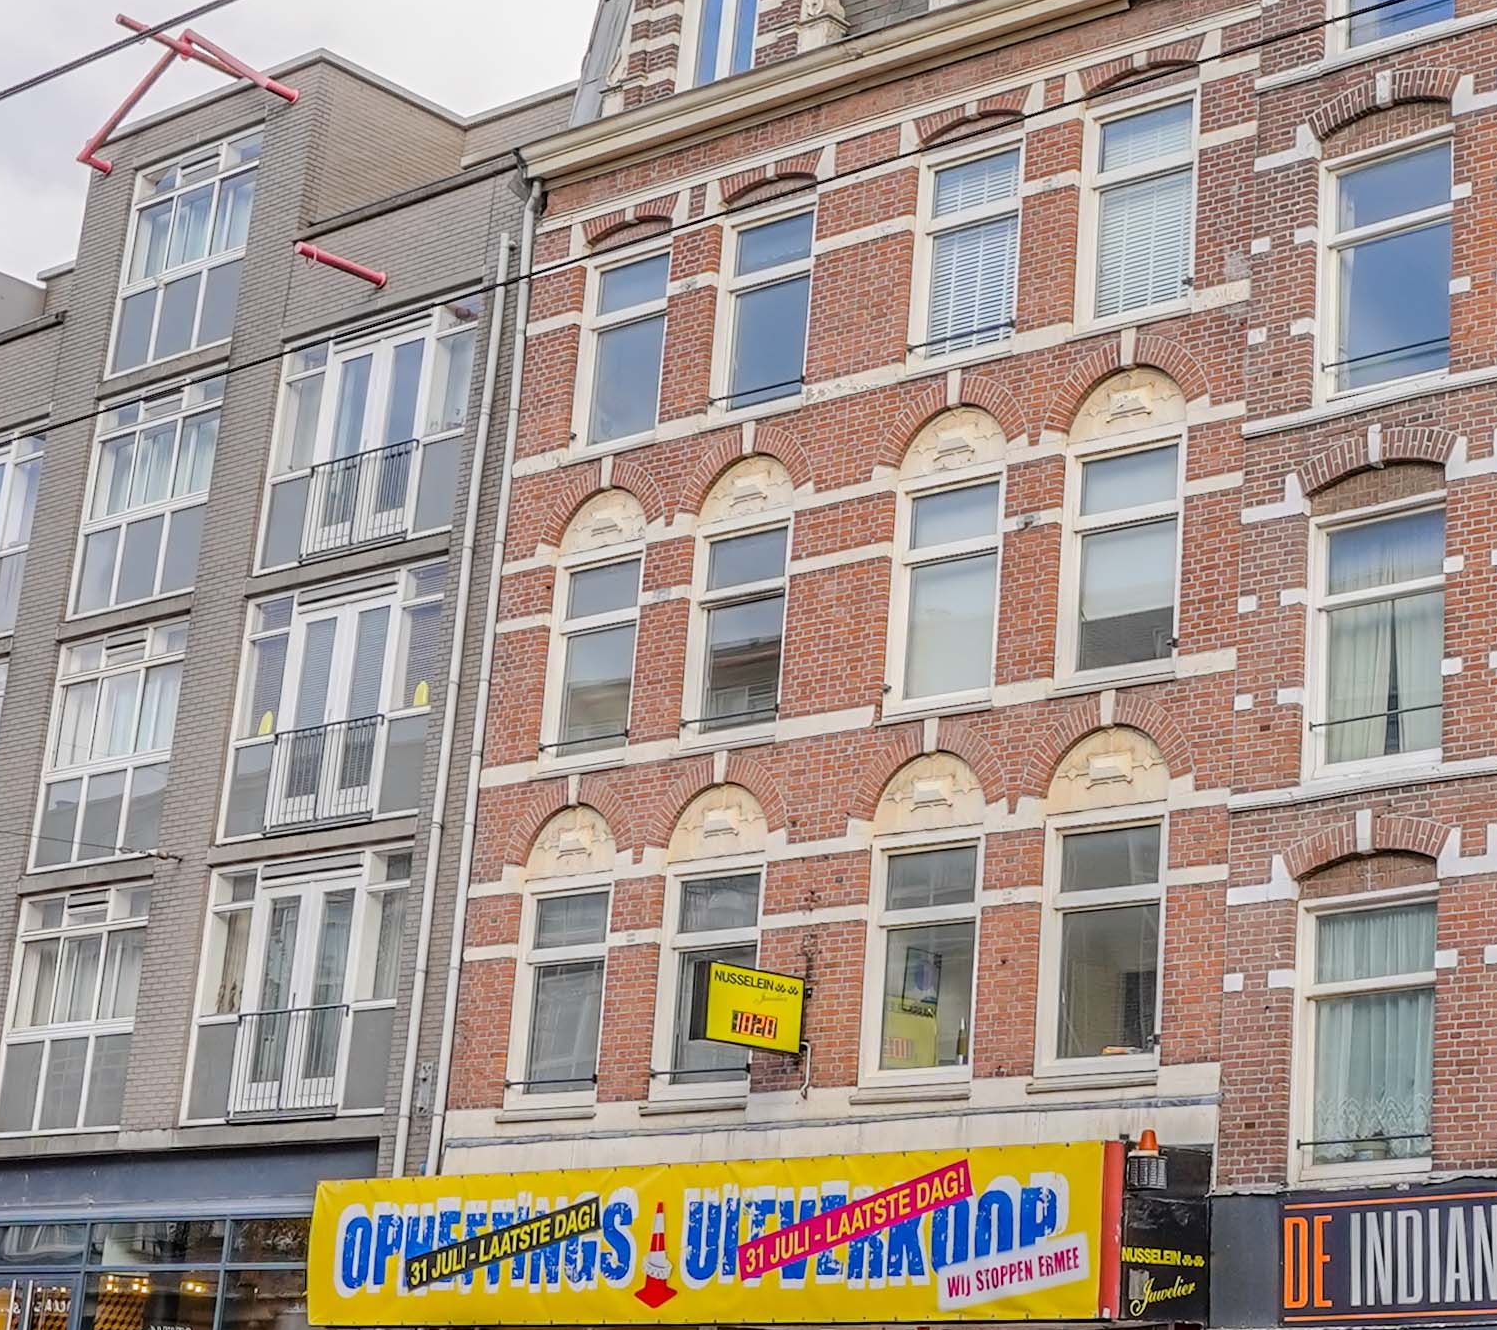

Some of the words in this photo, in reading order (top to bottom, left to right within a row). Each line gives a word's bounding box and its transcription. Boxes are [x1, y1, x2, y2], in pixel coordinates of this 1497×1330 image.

[715, 970, 774, 992] NUSSELEIN
[409, 1259, 428, 1286] 31
[432, 1250, 467, 1278] JULI
[479, 1215, 552, 1263] LAATSTE
[553, 1201, 597, 1241] DAG!
[745, 1245, 765, 1274] 31
[769, 1229, 810, 1266] JULI
[825, 1194, 914, 1243] LAATSTE
[918, 1167, 966, 1214] DAG!
[946, 1275, 971, 1298] WIJ
[976, 1259, 1033, 1292] STOPPEN
[1038, 1248, 1080, 1278] ERMEE
[1121, 1246, 1182, 1266] NUSSELEIN
[1284, 1214, 1333, 1309] DE
[1129, 1275, 1196, 1317] Juwelier
